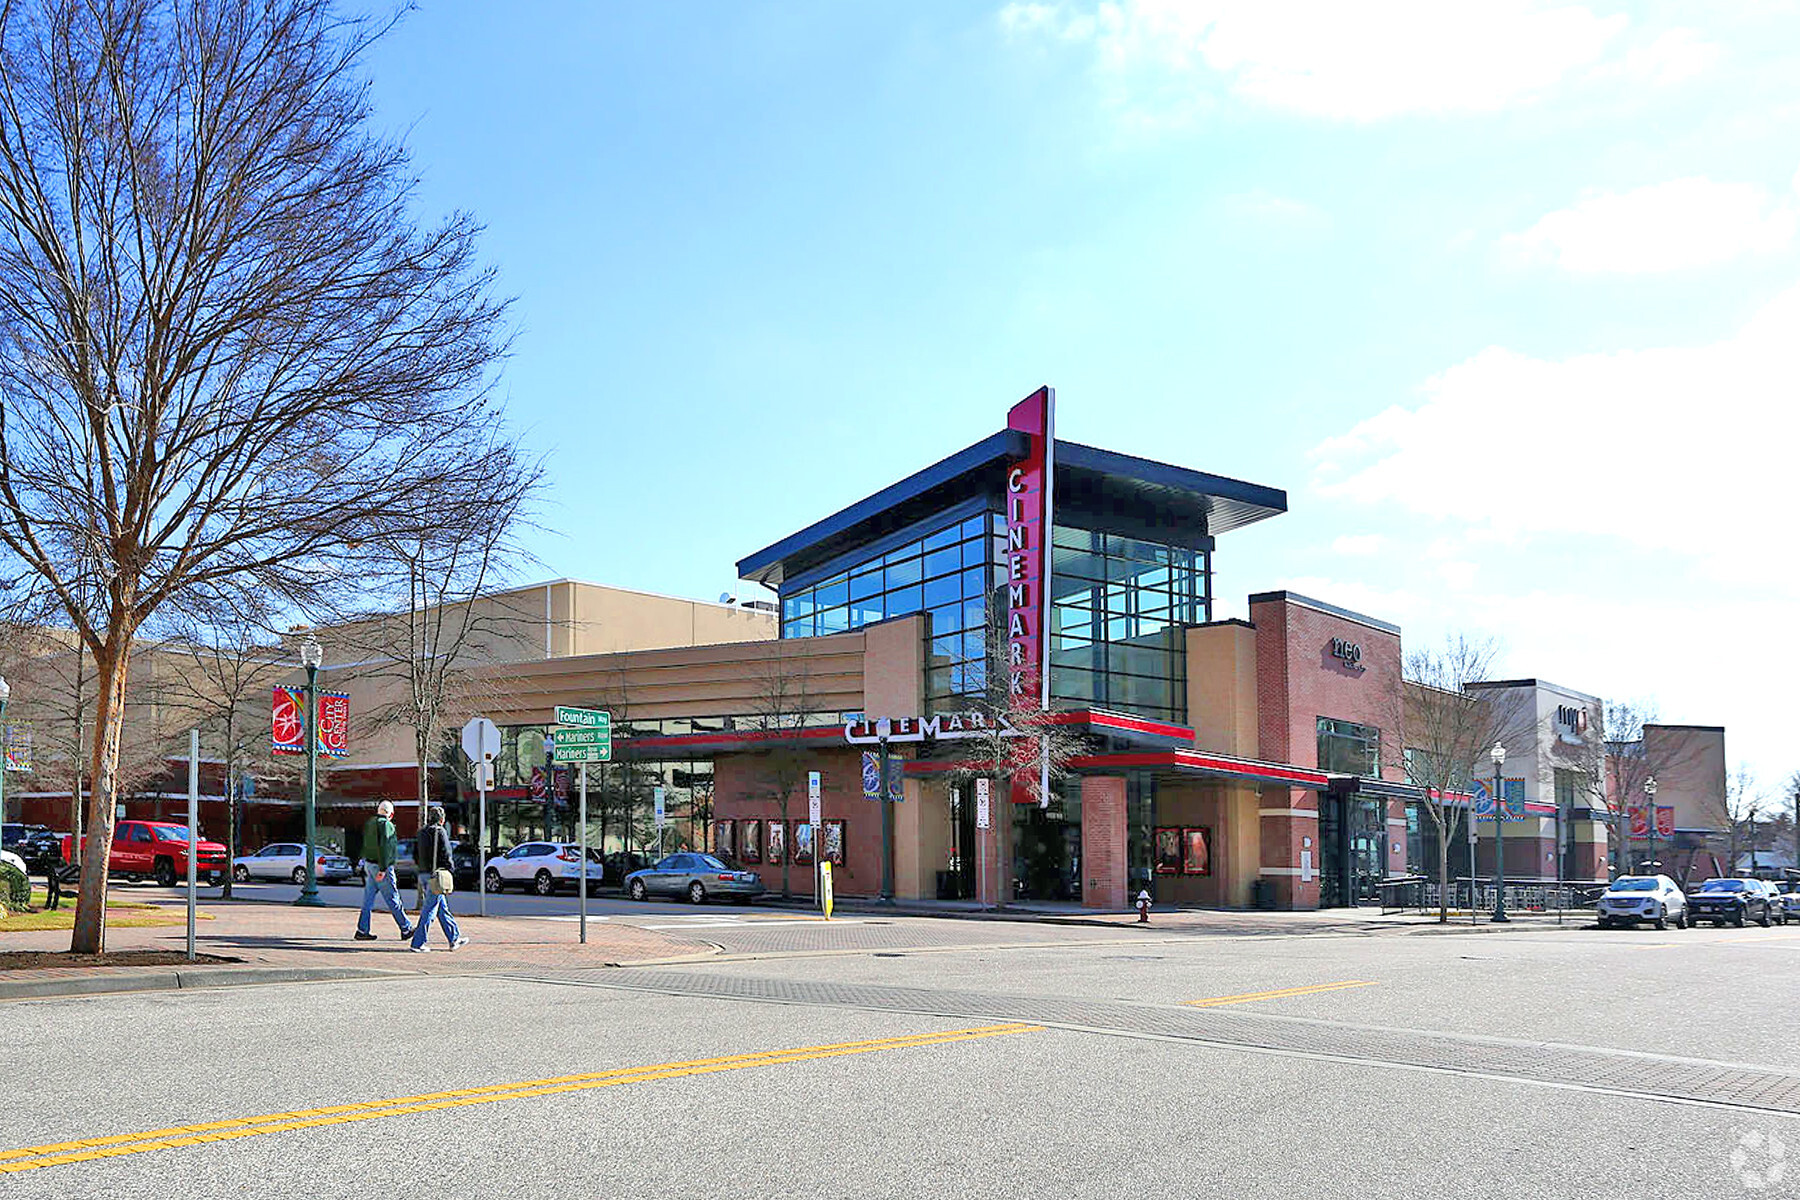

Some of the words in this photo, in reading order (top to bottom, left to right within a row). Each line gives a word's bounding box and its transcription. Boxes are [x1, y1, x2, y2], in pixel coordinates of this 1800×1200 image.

[1008, 468, 1025, 695] CINEMARK
[560, 710, 596, 725] Fountain
[565, 730, 595, 743] Mariners
[556, 747, 587, 760] Mariners
